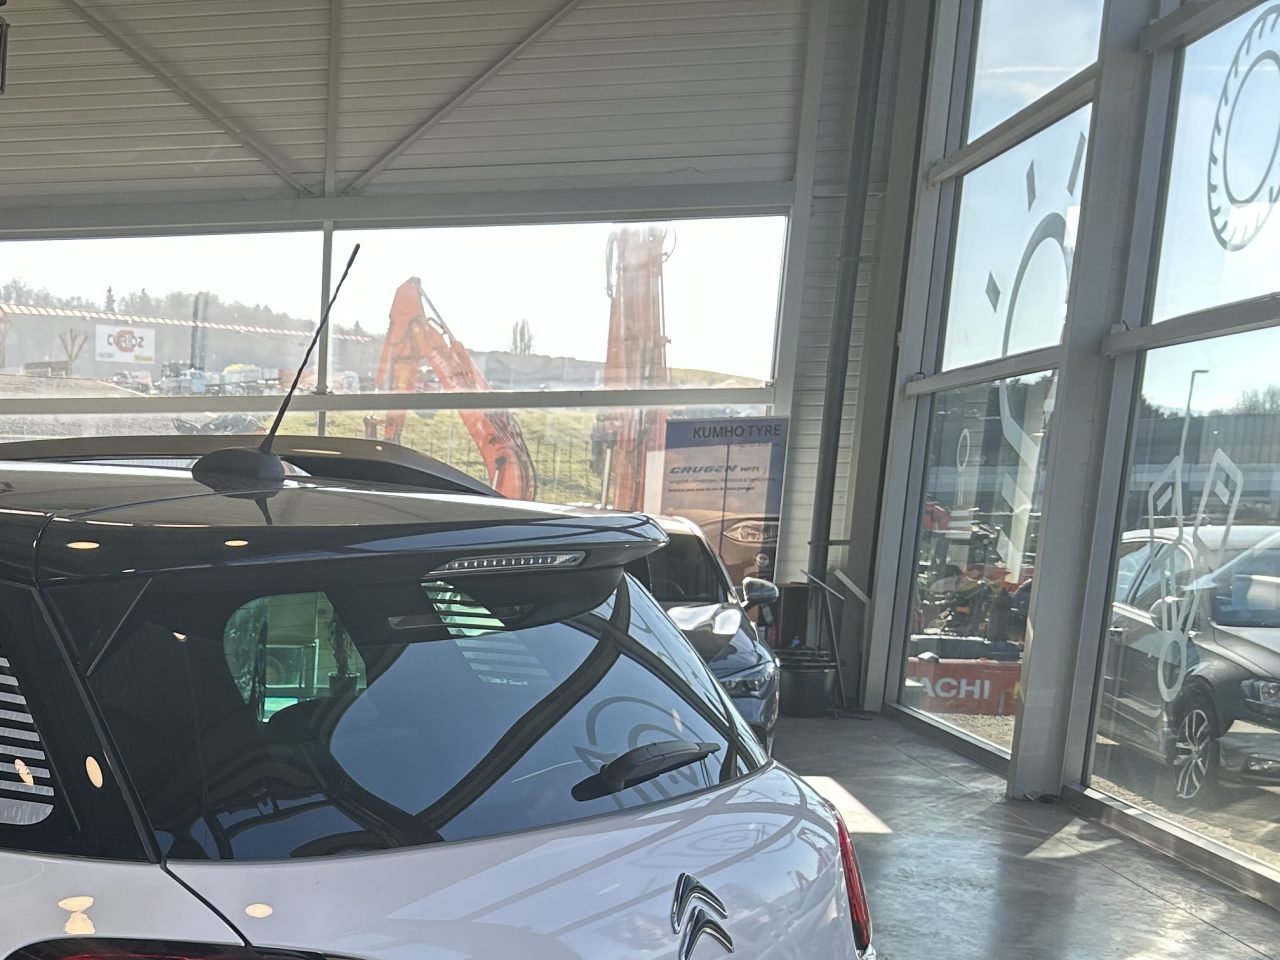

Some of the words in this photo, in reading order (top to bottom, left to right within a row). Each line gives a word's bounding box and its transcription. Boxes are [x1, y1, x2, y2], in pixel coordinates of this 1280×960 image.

[693, 425, 745, 439] KUMHO
[748, 424, 782, 436] TYRE
[670, 465, 738, 475] CRUGEN
